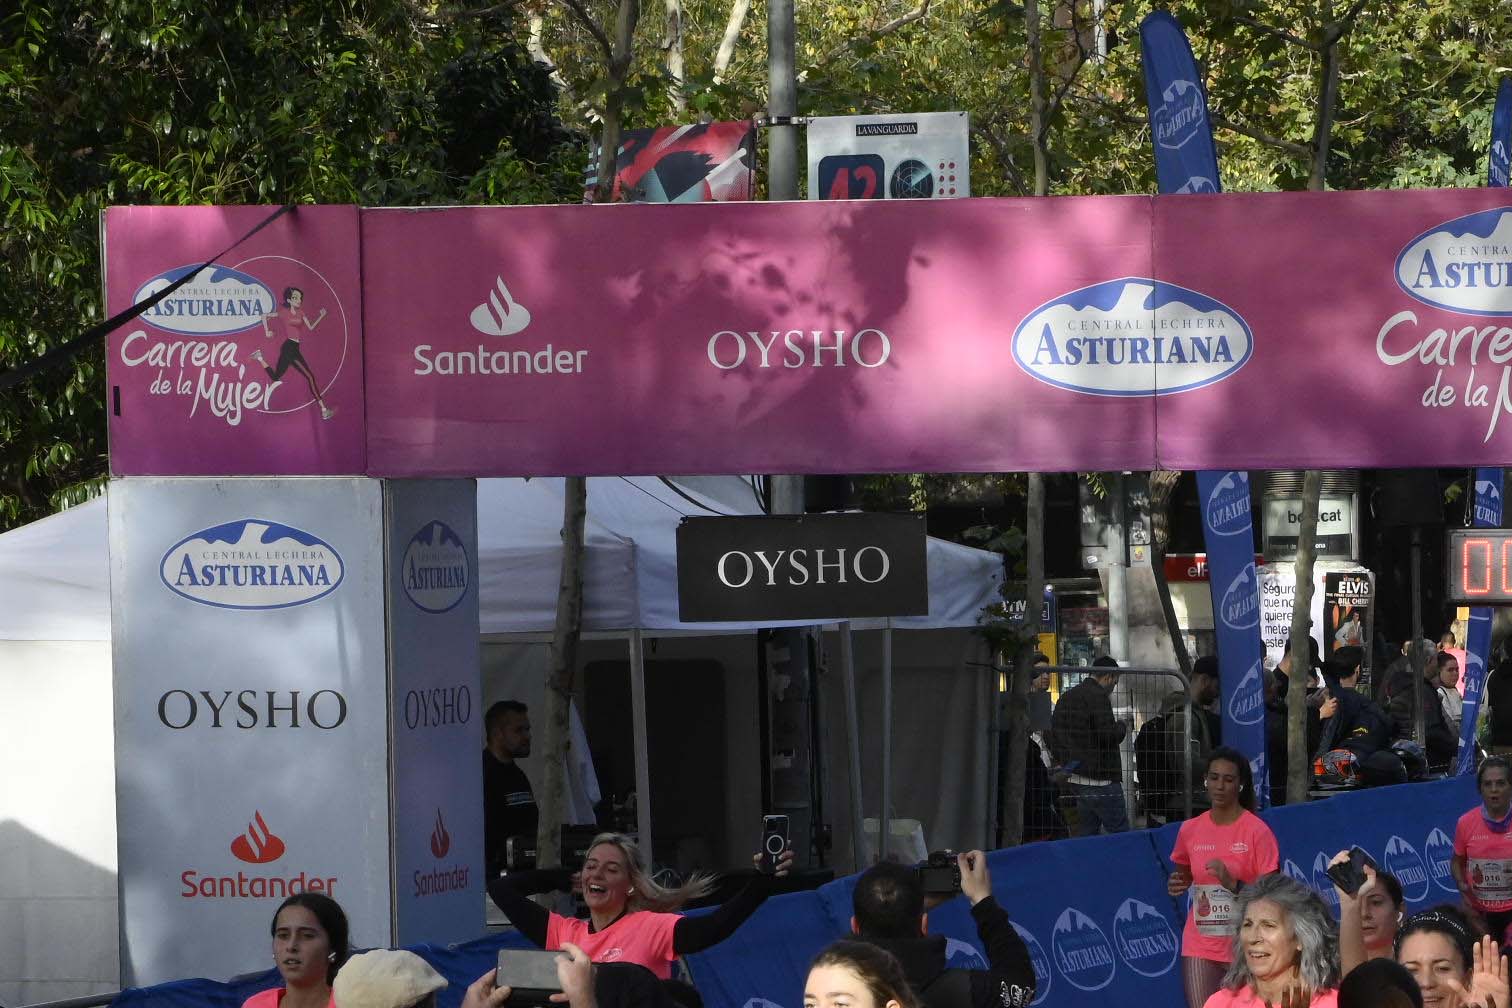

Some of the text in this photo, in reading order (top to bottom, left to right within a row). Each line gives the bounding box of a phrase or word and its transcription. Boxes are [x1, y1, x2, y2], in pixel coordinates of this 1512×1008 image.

[866, 124, 917, 135] VANGUARDIA
[1067, 318, 1226, 331] CENTRAL LECHERA
[120, 330, 239, 368] Carrera
[413, 344, 589, 376] Santander
[707, 328, 892, 370] OYSHO
[1030, 322, 1235, 366] ASTURIANA
[150, 363, 284, 426] de la Mujer
[1421, 369, 1456, 408] de
[1463, 367, 1489, 408] la
[174, 552, 332, 587] ASTURIANA
[202, 550, 326, 560] CENTRAL LECHERA
[408, 554, 466, 590] ASTURIANA
[717, 546, 891, 589] OYSHO
[1264, 598, 1281, 610] que
[1338, 581, 1369, 594] ELVIS
[157, 689, 348, 730] OYSHO
[405, 685, 472, 731] OYSHO
[413, 864, 470, 898] Santander
[1211, 904, 1231, 913] 016
